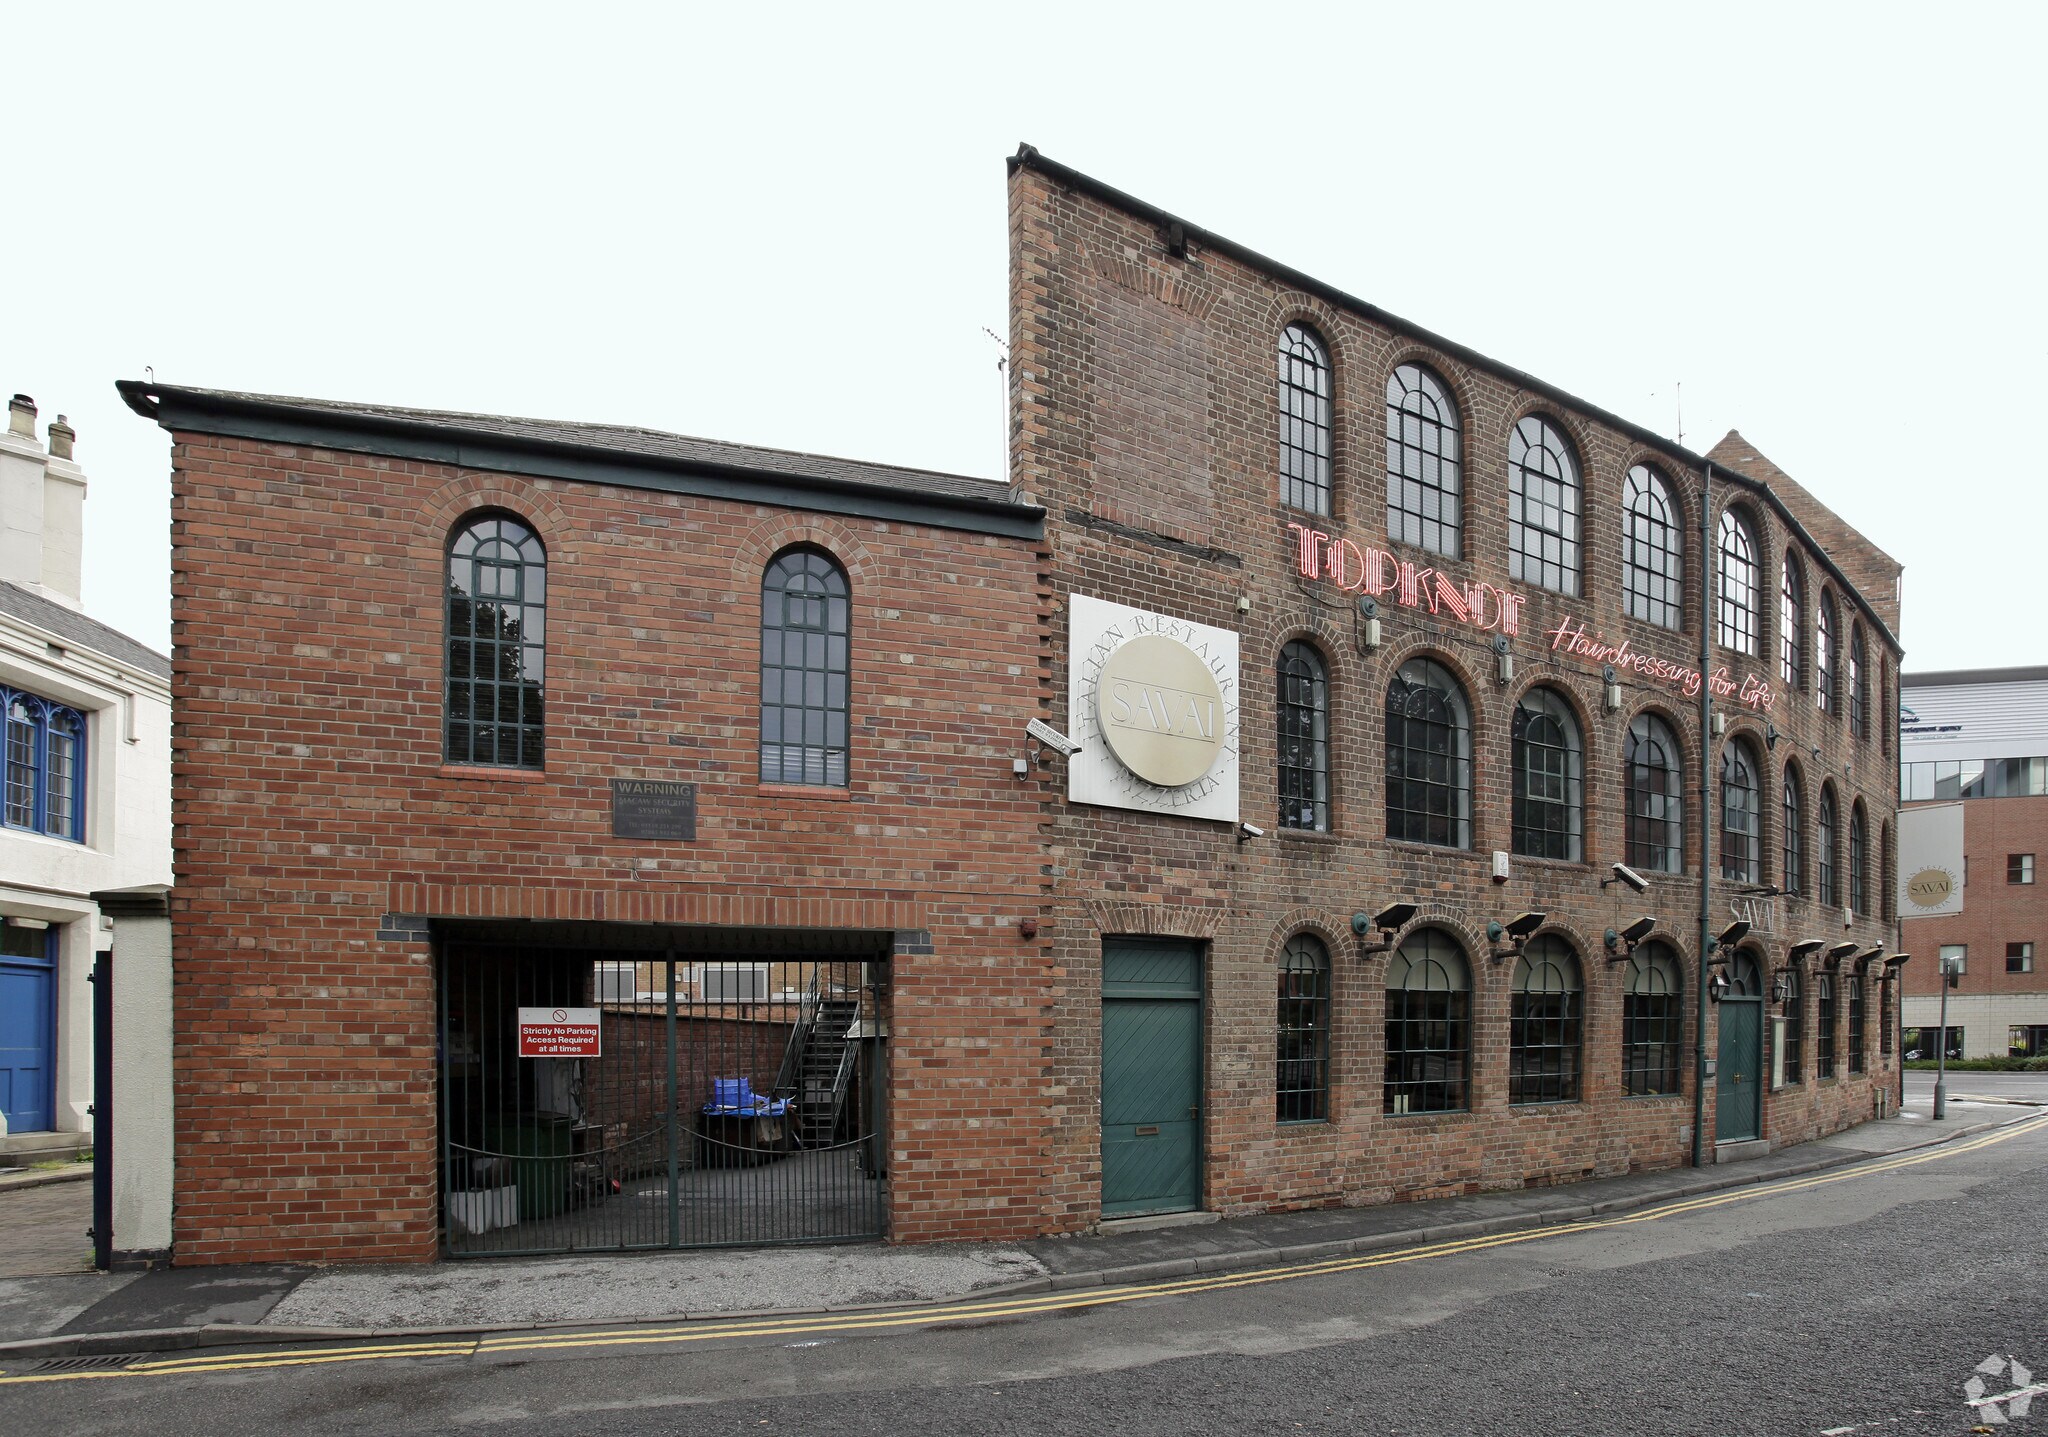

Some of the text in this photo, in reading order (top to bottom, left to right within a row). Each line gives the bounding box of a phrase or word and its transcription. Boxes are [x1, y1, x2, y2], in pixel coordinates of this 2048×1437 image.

[1547, 615, 1702, 696] Hairdressing
[1708, 666, 1737, 696] for
[1075, 613, 1240, 763] ITALIAN RESTAURANT
[618, 782, 691, 797] WARNING
[1910, 881, 1949, 895] SAVAI
[522, 1027, 597, 1036] Strictly No Parking
[526, 1036, 594, 1045] Access Required
[549, 1045, 558, 1053] all
[559, 1045, 582, 1053] times
